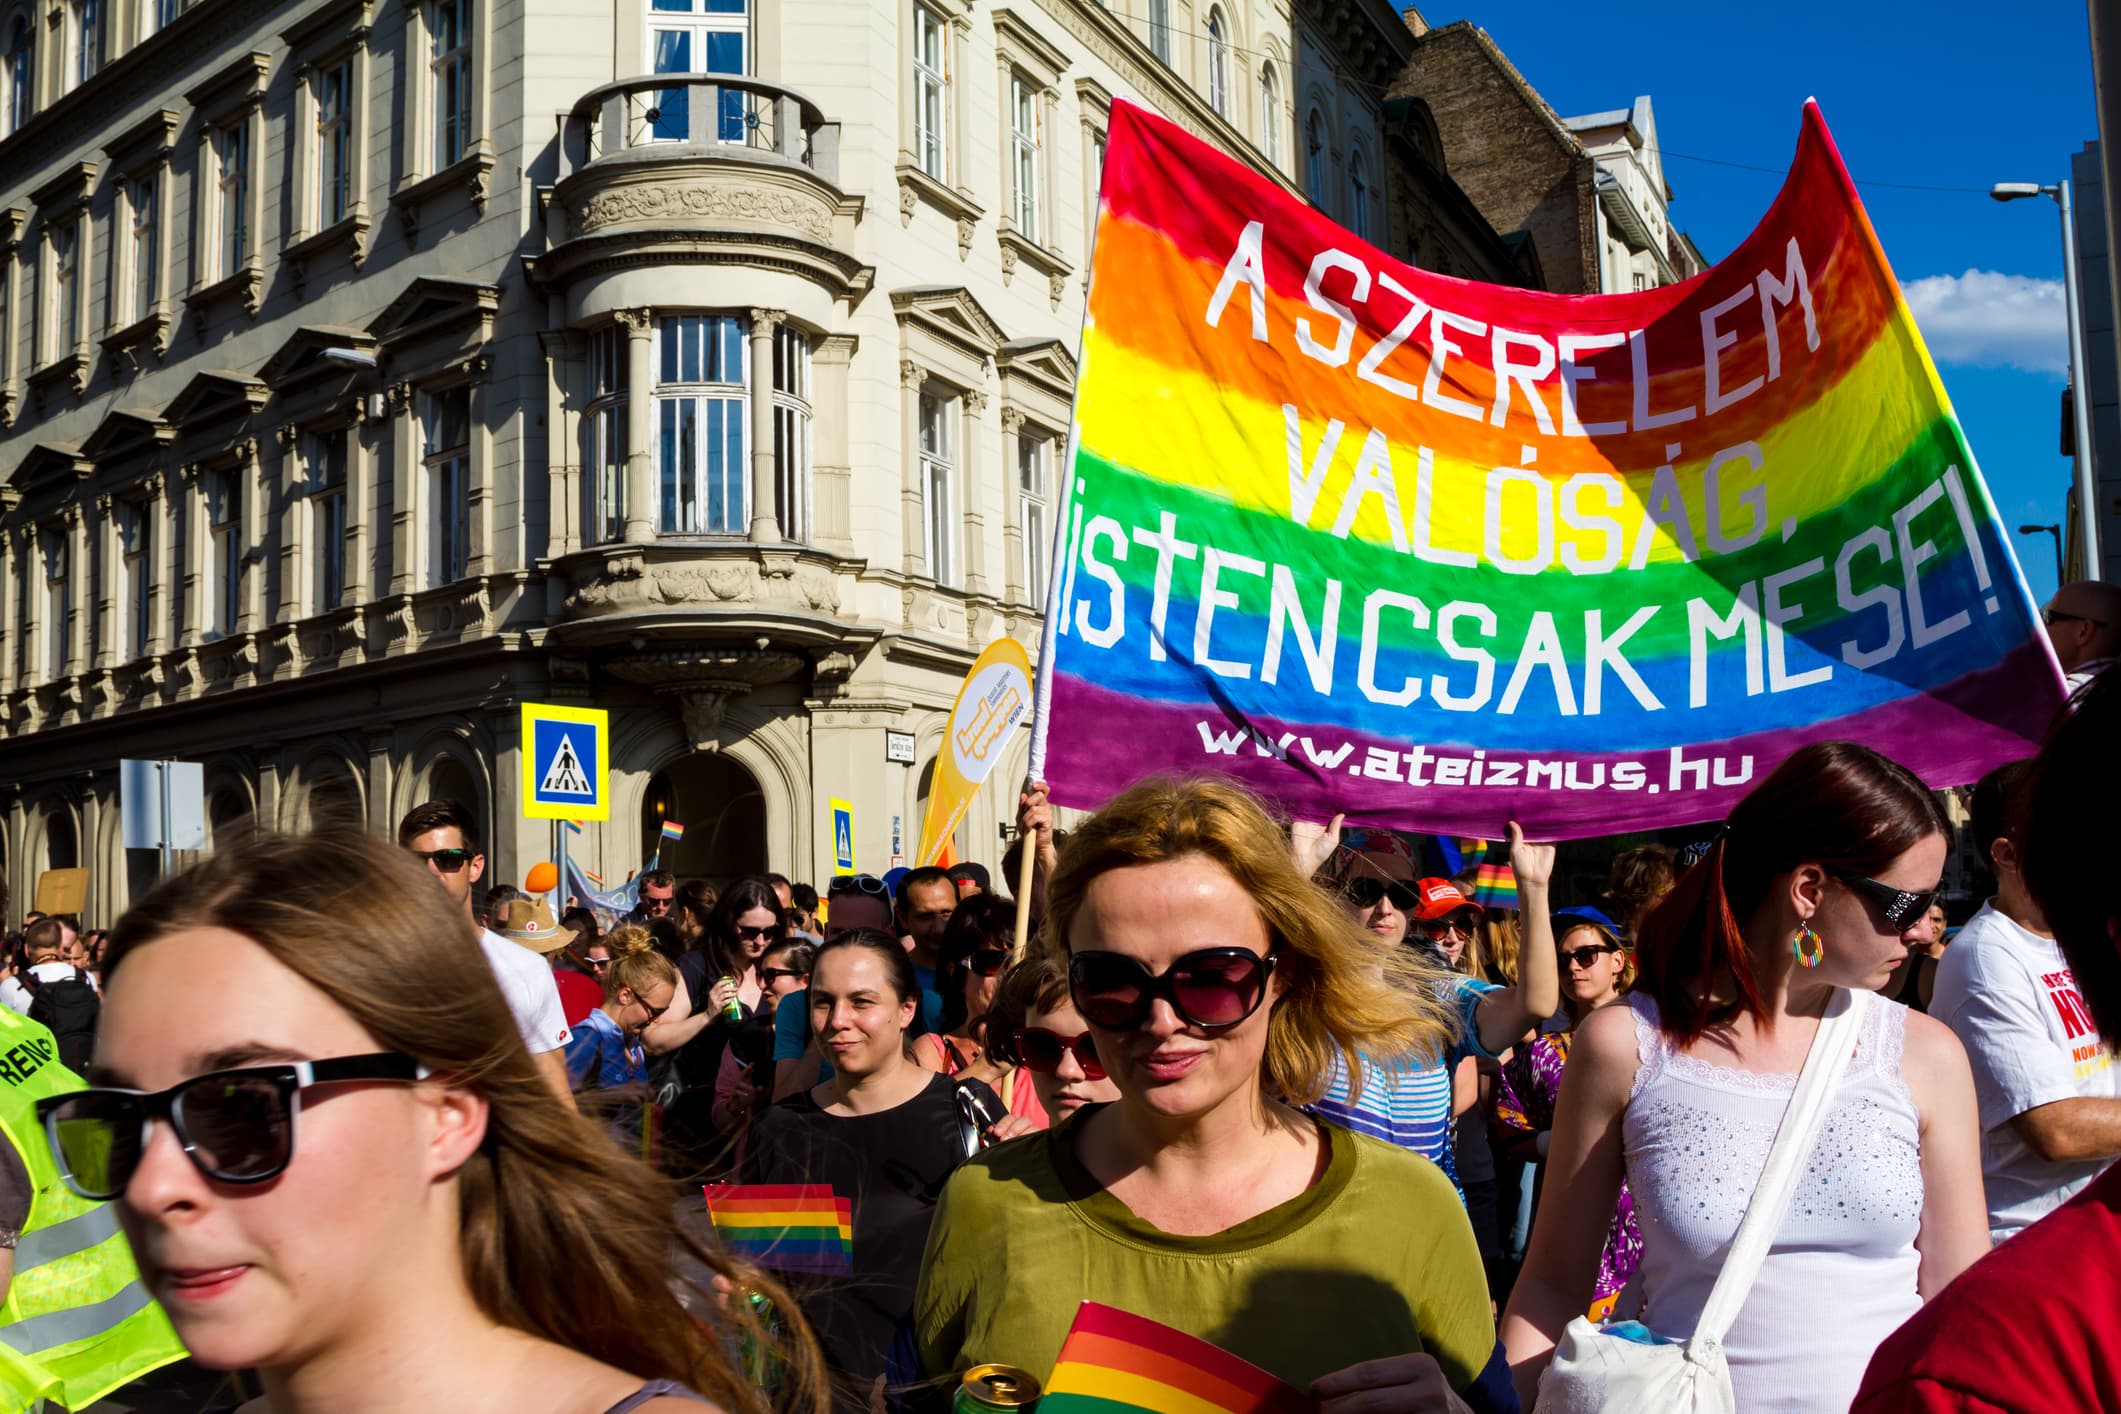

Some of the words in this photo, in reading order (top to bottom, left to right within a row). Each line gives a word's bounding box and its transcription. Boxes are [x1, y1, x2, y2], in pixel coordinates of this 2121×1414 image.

[1206, 220, 1268, 343] A
[1296, 235, 1821, 437] SZERELEM
[1281, 403, 1797, 576] VALÓSÁG,
[1357, 588, 1664, 716] CSAK
[1687, 464, 2000, 709] MESE!
